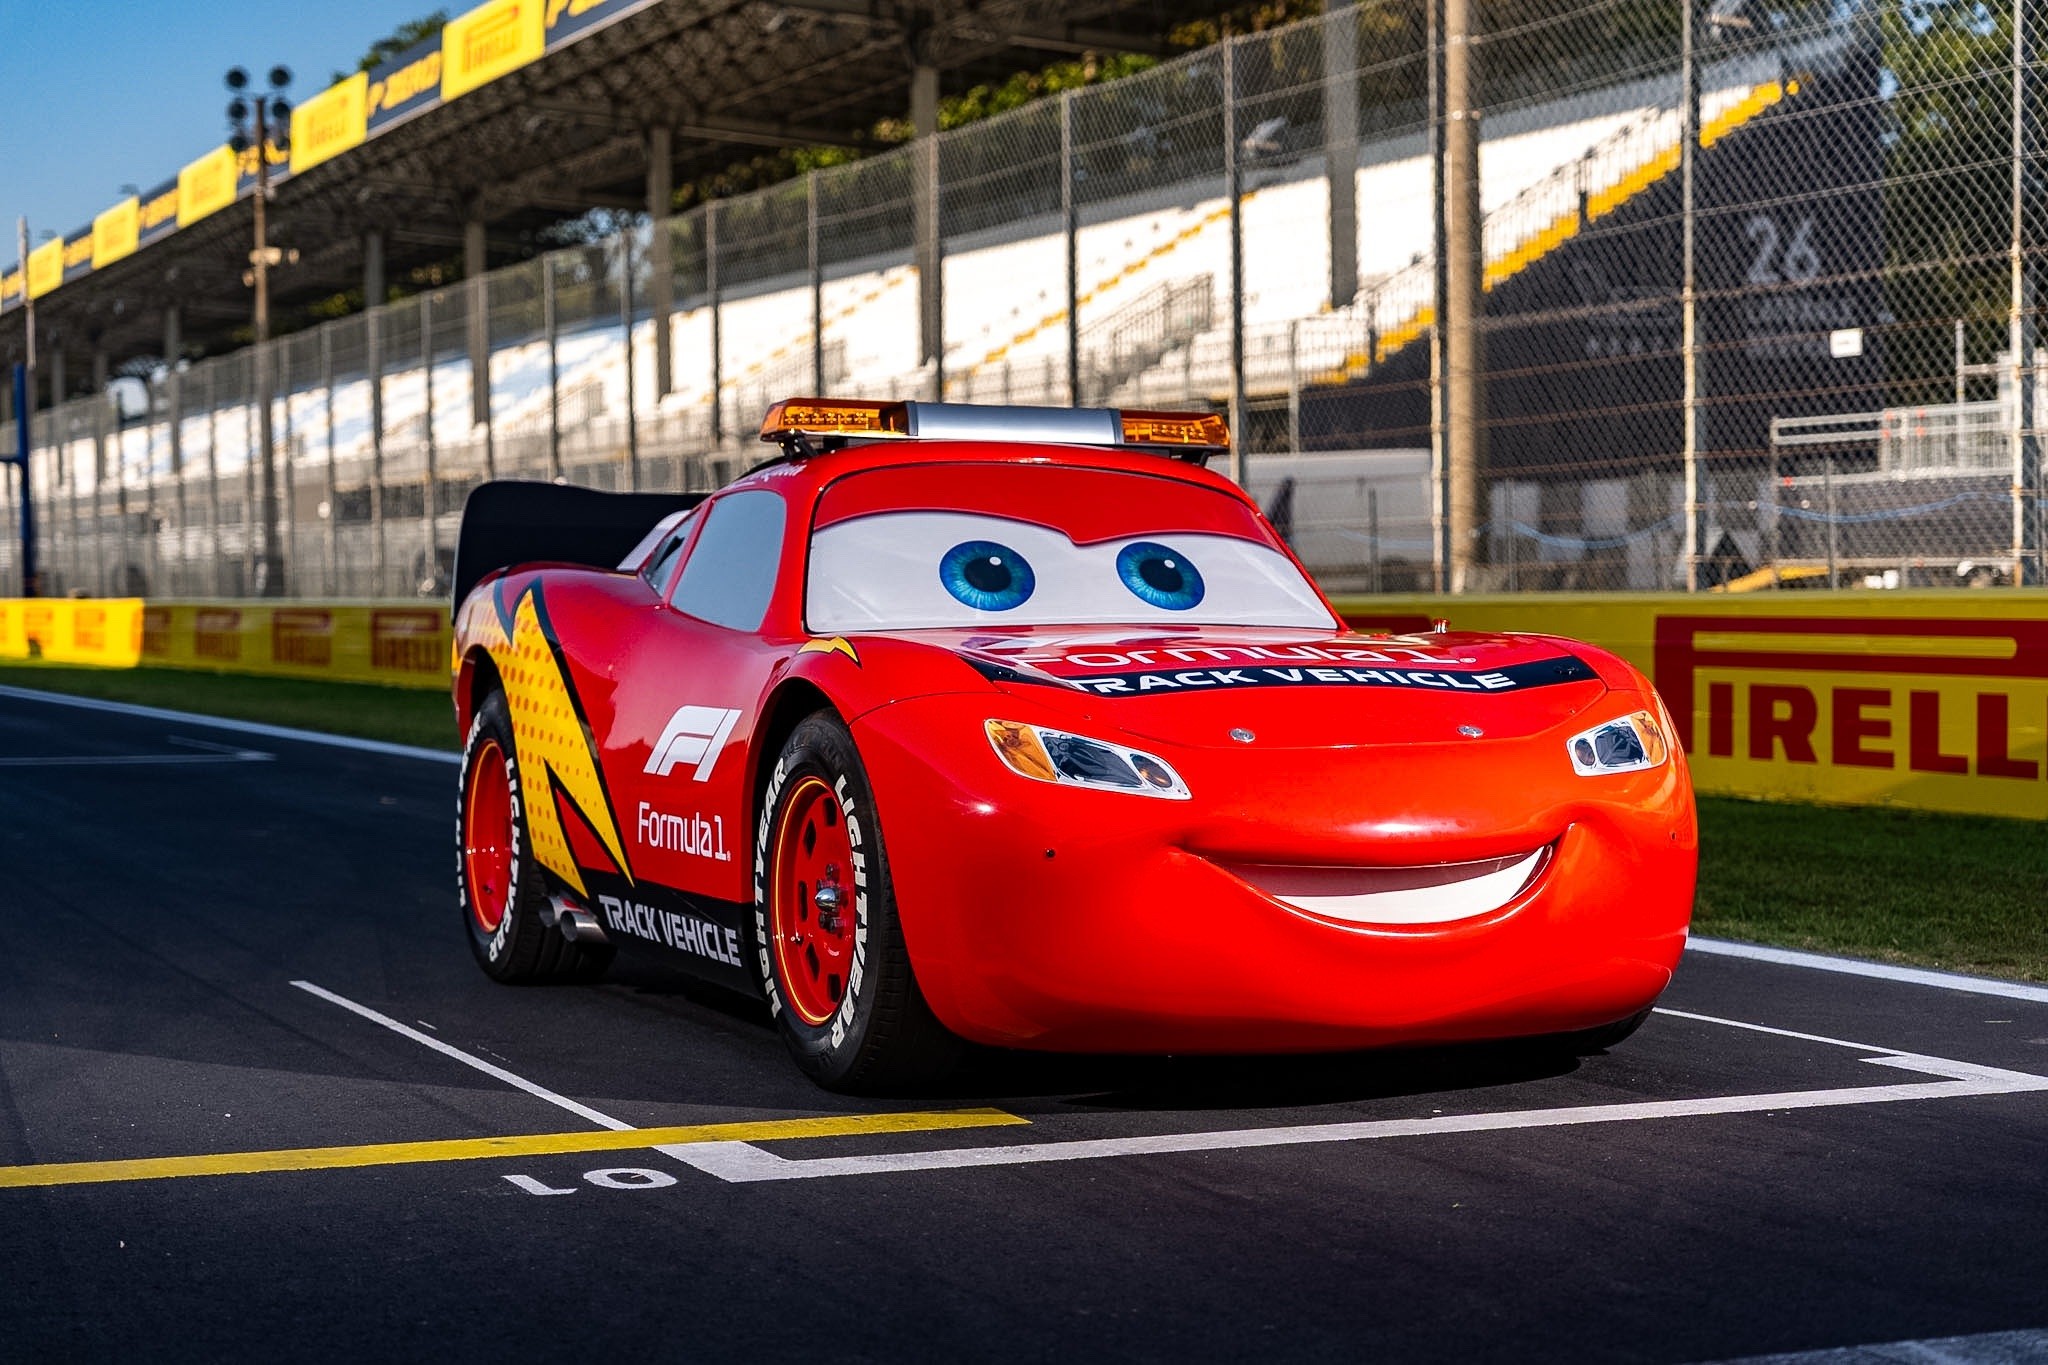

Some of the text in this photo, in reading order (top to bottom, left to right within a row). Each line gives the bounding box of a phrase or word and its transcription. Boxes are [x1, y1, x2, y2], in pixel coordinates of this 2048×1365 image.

[1747, 217, 1820, 281] 26
[1066, 668, 1516, 693] TRACK VEHICLE
[1653, 615, 2048, 780] PIRELL
[643, 705, 743, 783] F1
[754, 758, 787, 1019] LIGHTYEAR
[836, 774, 868, 1048] LIGHTYEAR
[598, 895, 742, 968] TRACK VEHICLE
